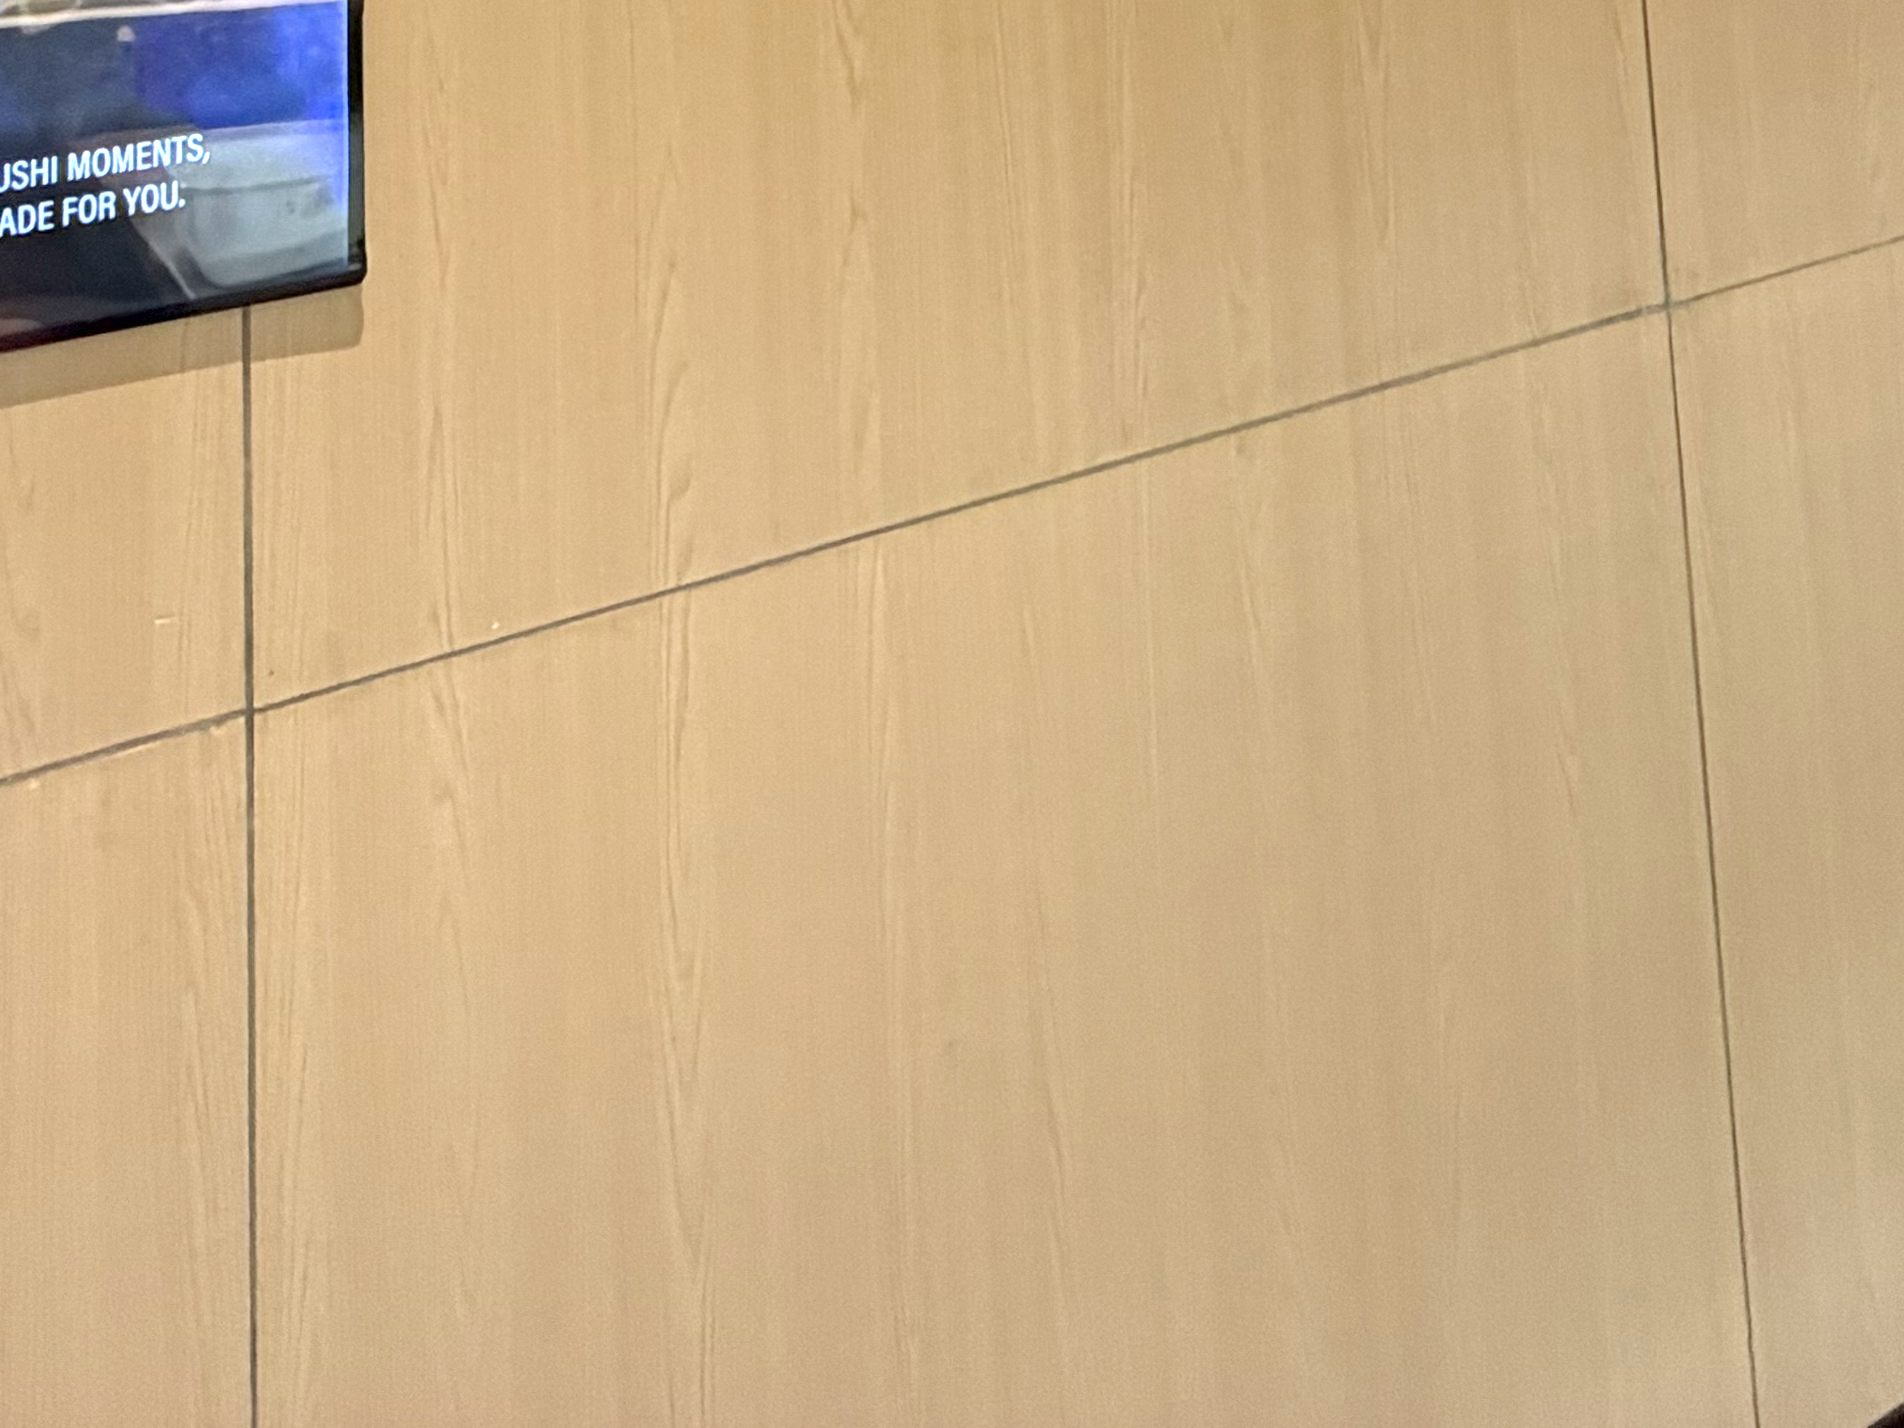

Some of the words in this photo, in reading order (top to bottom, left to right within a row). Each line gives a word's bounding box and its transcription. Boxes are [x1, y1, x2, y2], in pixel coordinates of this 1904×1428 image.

[67, 133, 210, 182] MOMENTS,
[62, 191, 116, 227] FOR
[123, 180, 186, 216] YOU.
